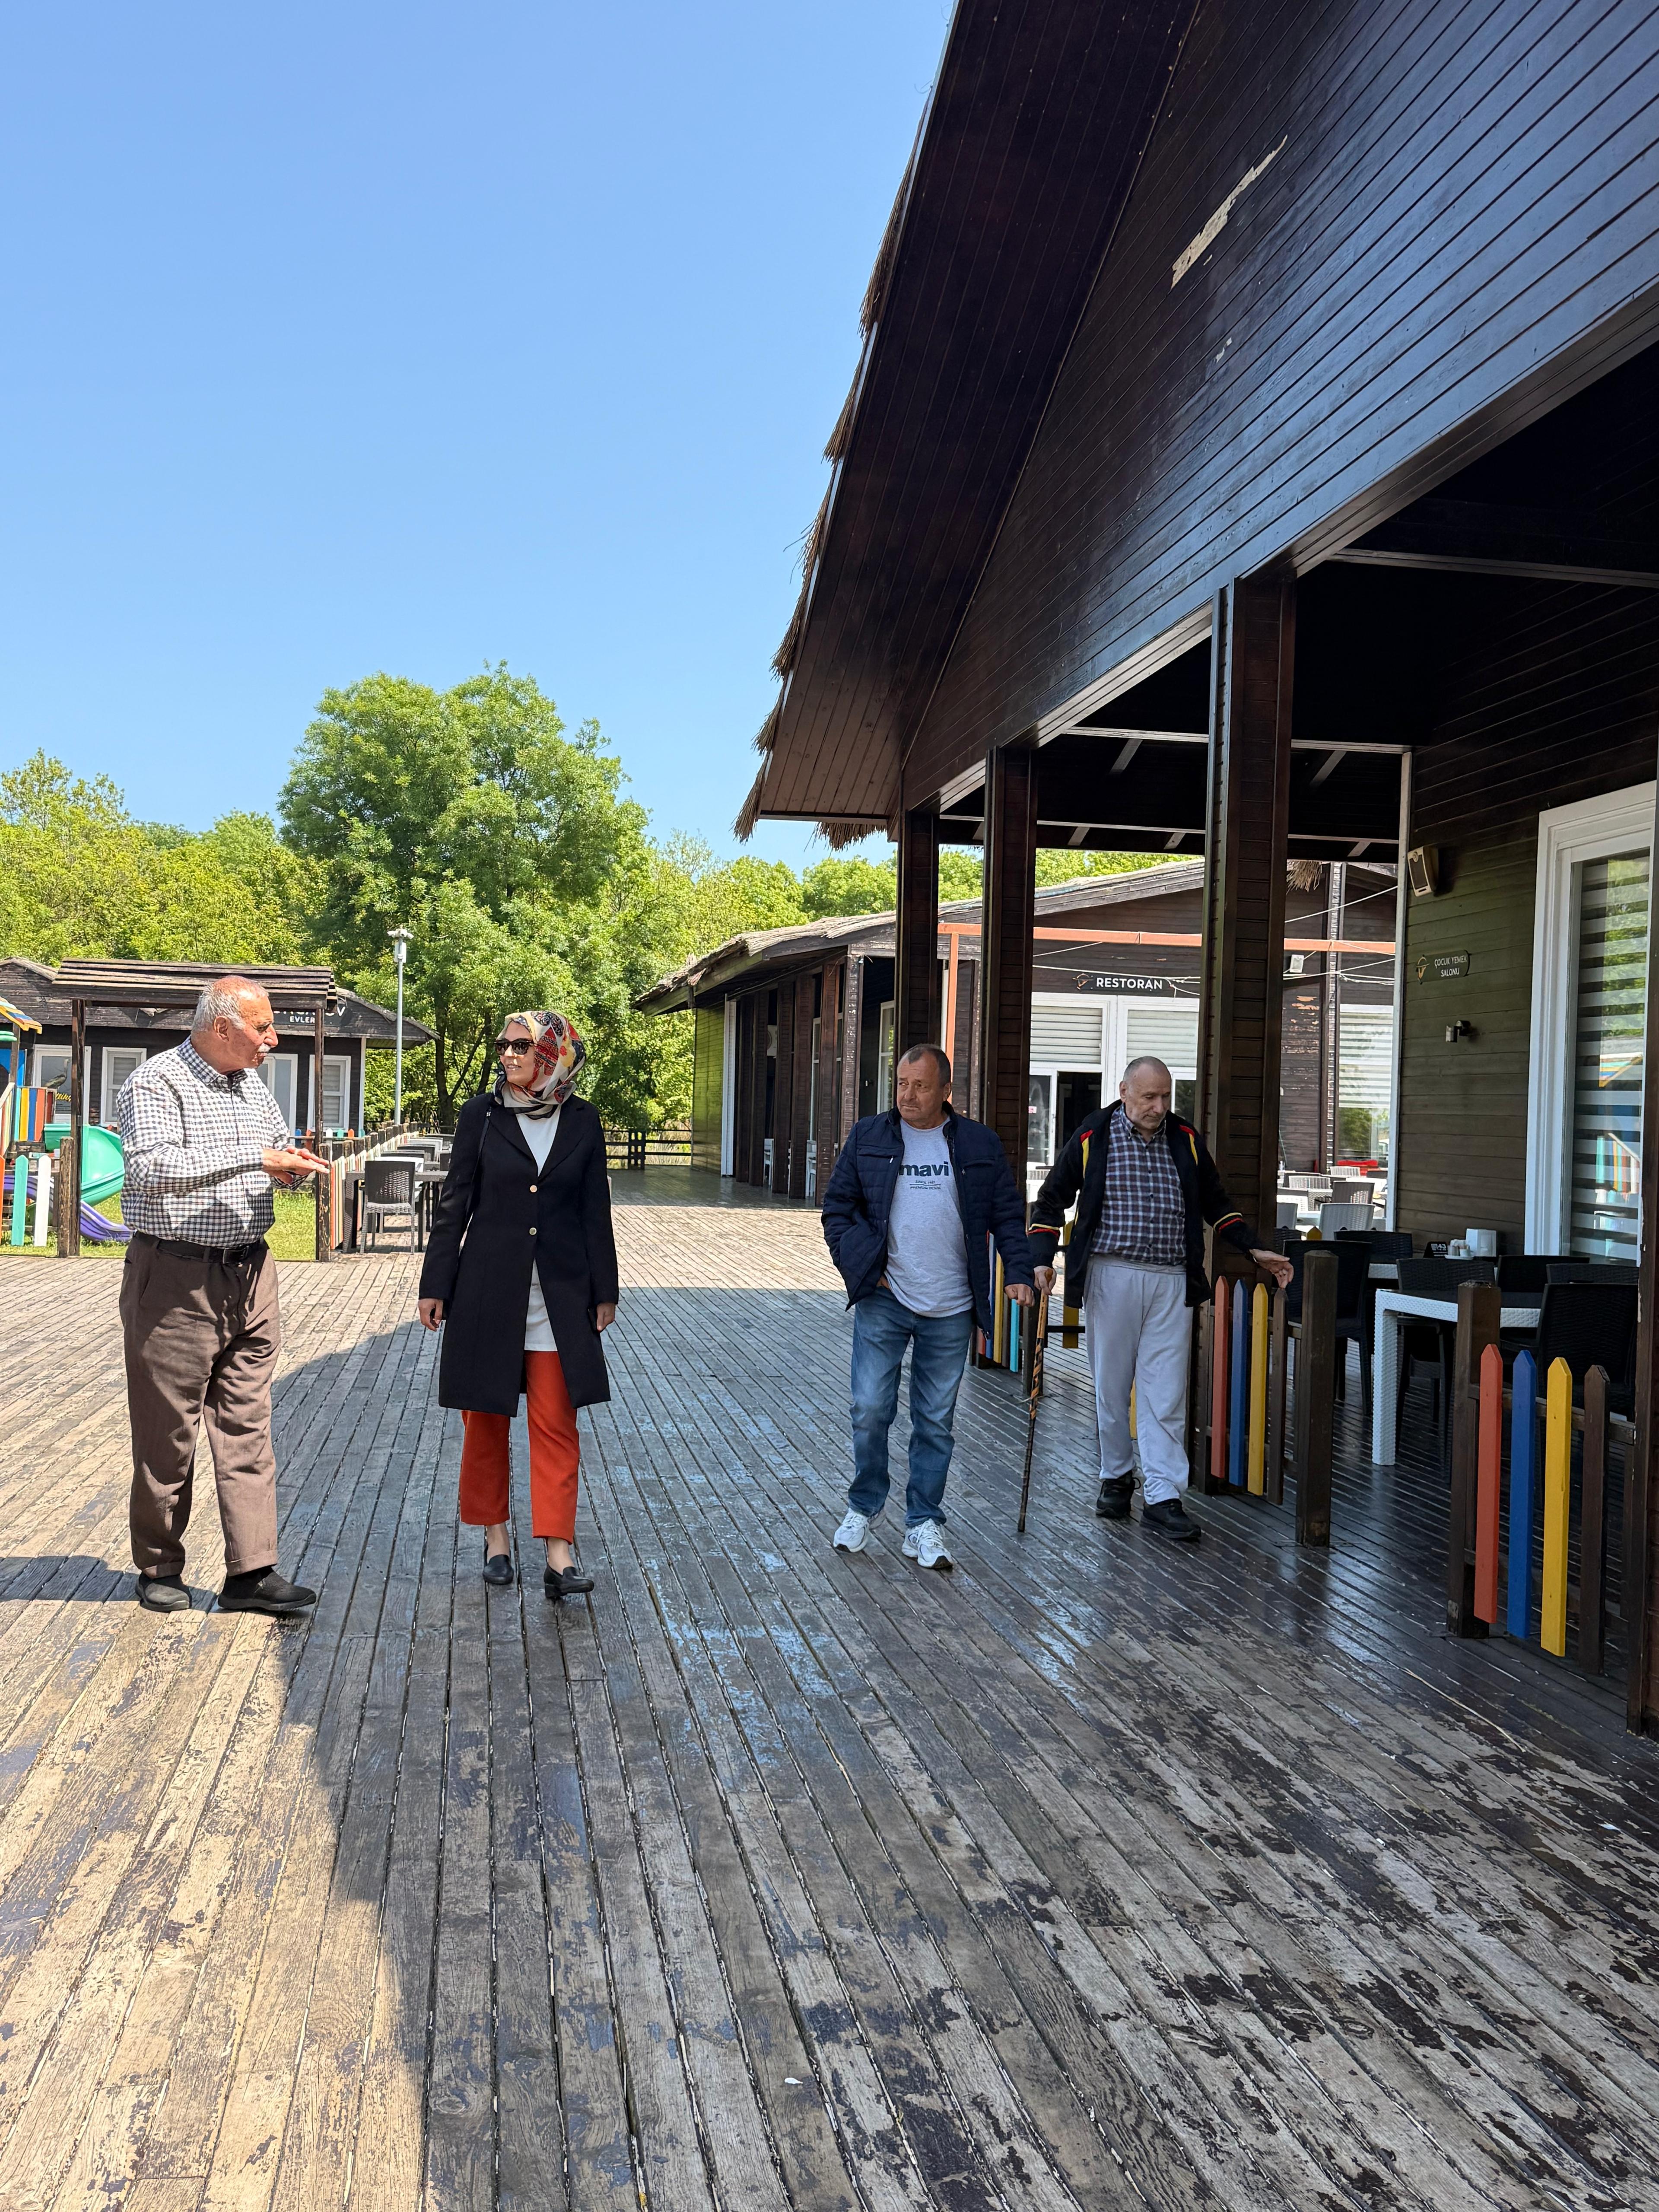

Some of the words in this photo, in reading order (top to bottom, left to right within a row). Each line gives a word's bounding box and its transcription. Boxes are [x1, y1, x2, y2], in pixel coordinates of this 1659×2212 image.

[1434, 957, 1450, 969] ÇOCUK
[1441, 968, 1459, 977] SALONU
[1096, 977, 1163, 990] RESTORAN
[899, 1161, 949, 1177] mavi
